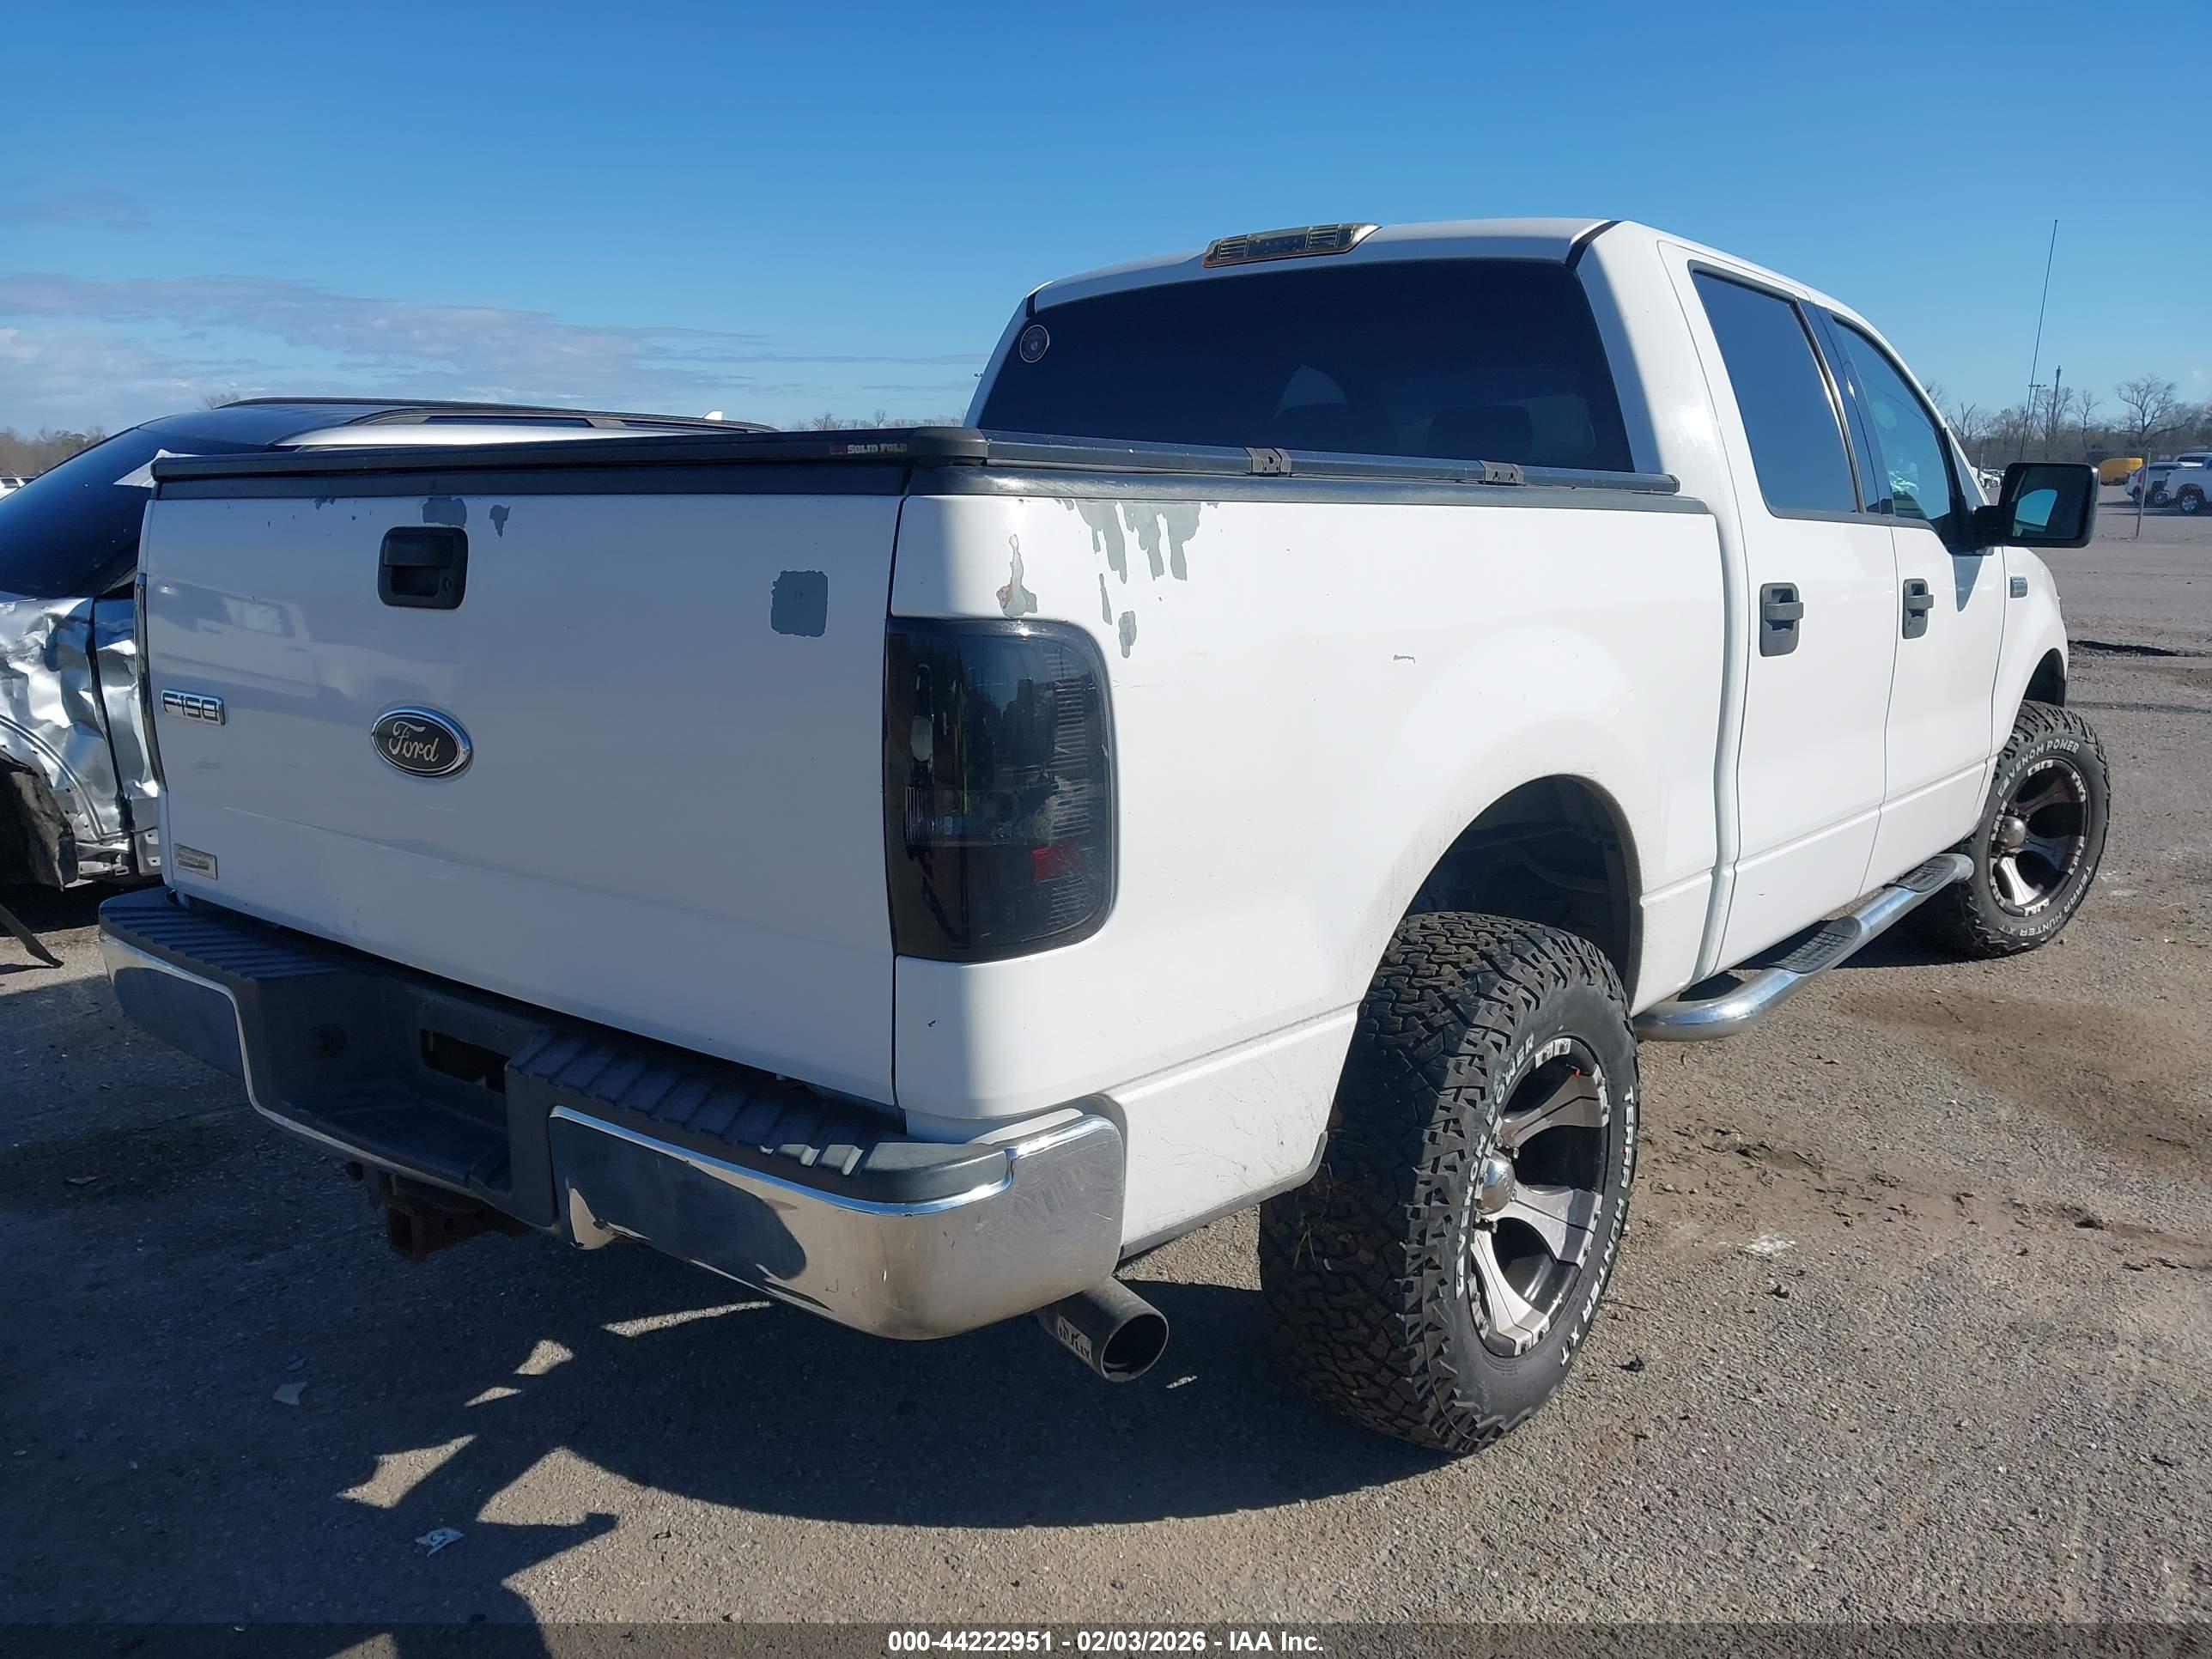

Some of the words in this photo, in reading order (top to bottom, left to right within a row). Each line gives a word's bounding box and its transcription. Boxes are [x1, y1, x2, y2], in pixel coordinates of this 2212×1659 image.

[848, 444, 878, 454] SOLID
[879, 443, 908, 454] FOLD
[388, 720, 440, 763] Ford
[2008, 743, 2044, 778] VENOM
[2046, 738, 2080, 754] POWER
[2019, 911, 2063, 937] HUNTER
[1457, 1133, 1486, 1254] VENOM
[1486, 1033, 1535, 1126] POWER
[1620, 1085, 1636, 1189] TERRA
[1582, 1197, 1625, 1323] HUNTER
